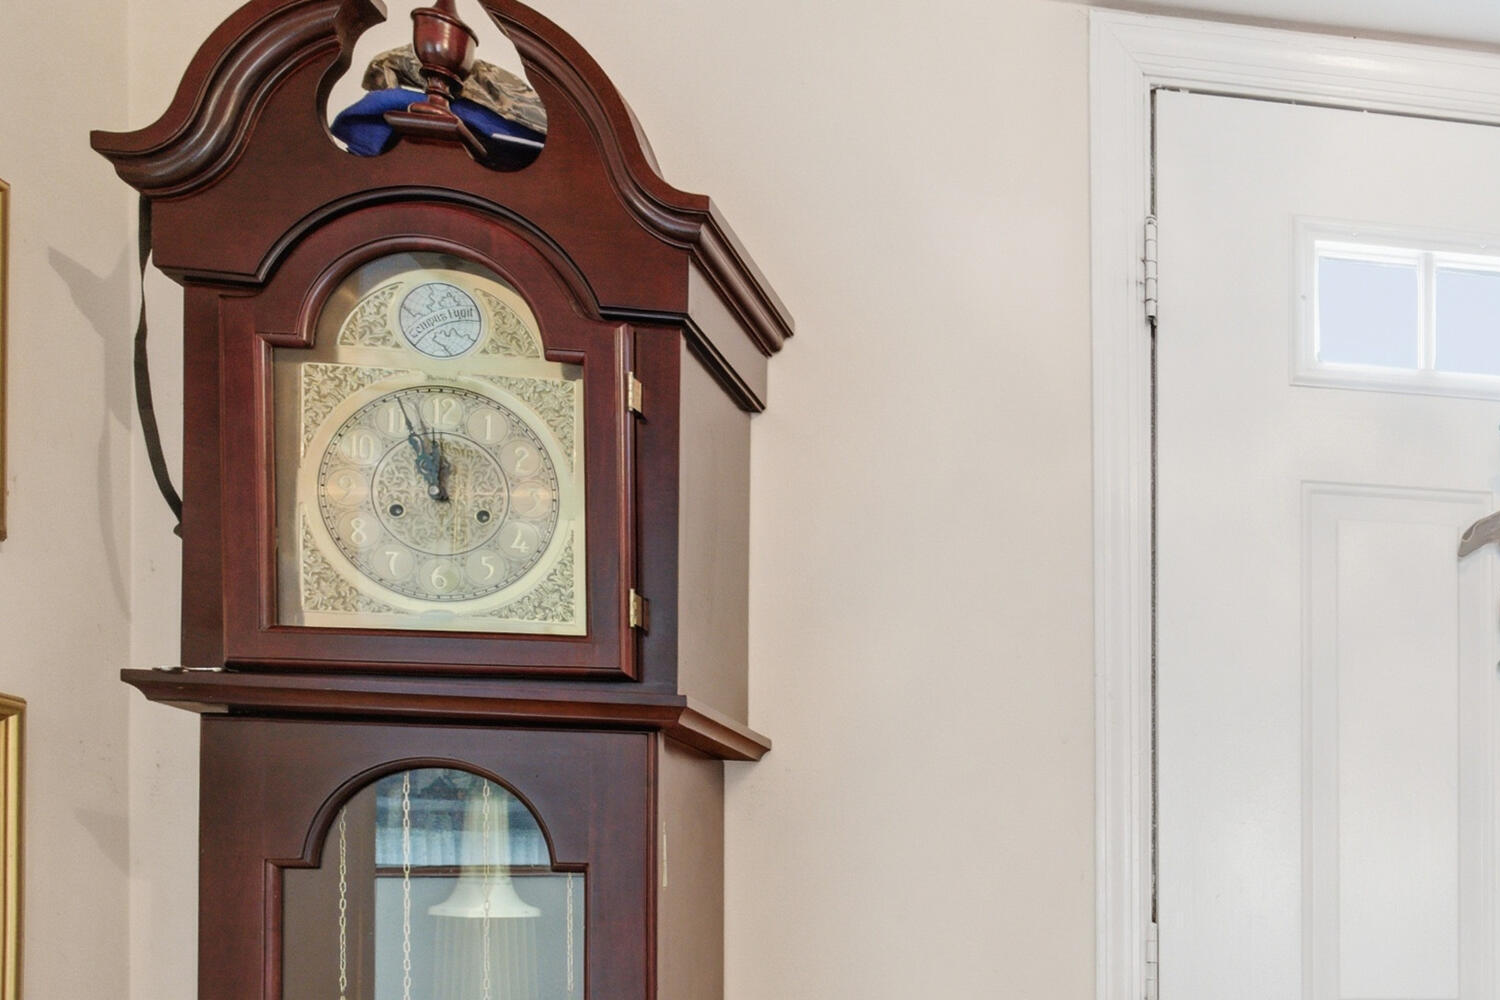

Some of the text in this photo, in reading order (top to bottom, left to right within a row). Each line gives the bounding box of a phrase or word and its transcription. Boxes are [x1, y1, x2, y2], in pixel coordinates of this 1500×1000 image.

[432, 397, 457, 425] 12
[484, 415, 494, 437] 1
[350, 434, 374, 461] 10
[514, 446, 531, 473] 2
[338, 477, 357, 505] 9
[351, 518, 368, 544] 8
[511, 526, 530, 552] 4
[385, 551, 400, 577] 7
[481, 554, 495, 580] 5
[431, 566, 447, 589] 6
